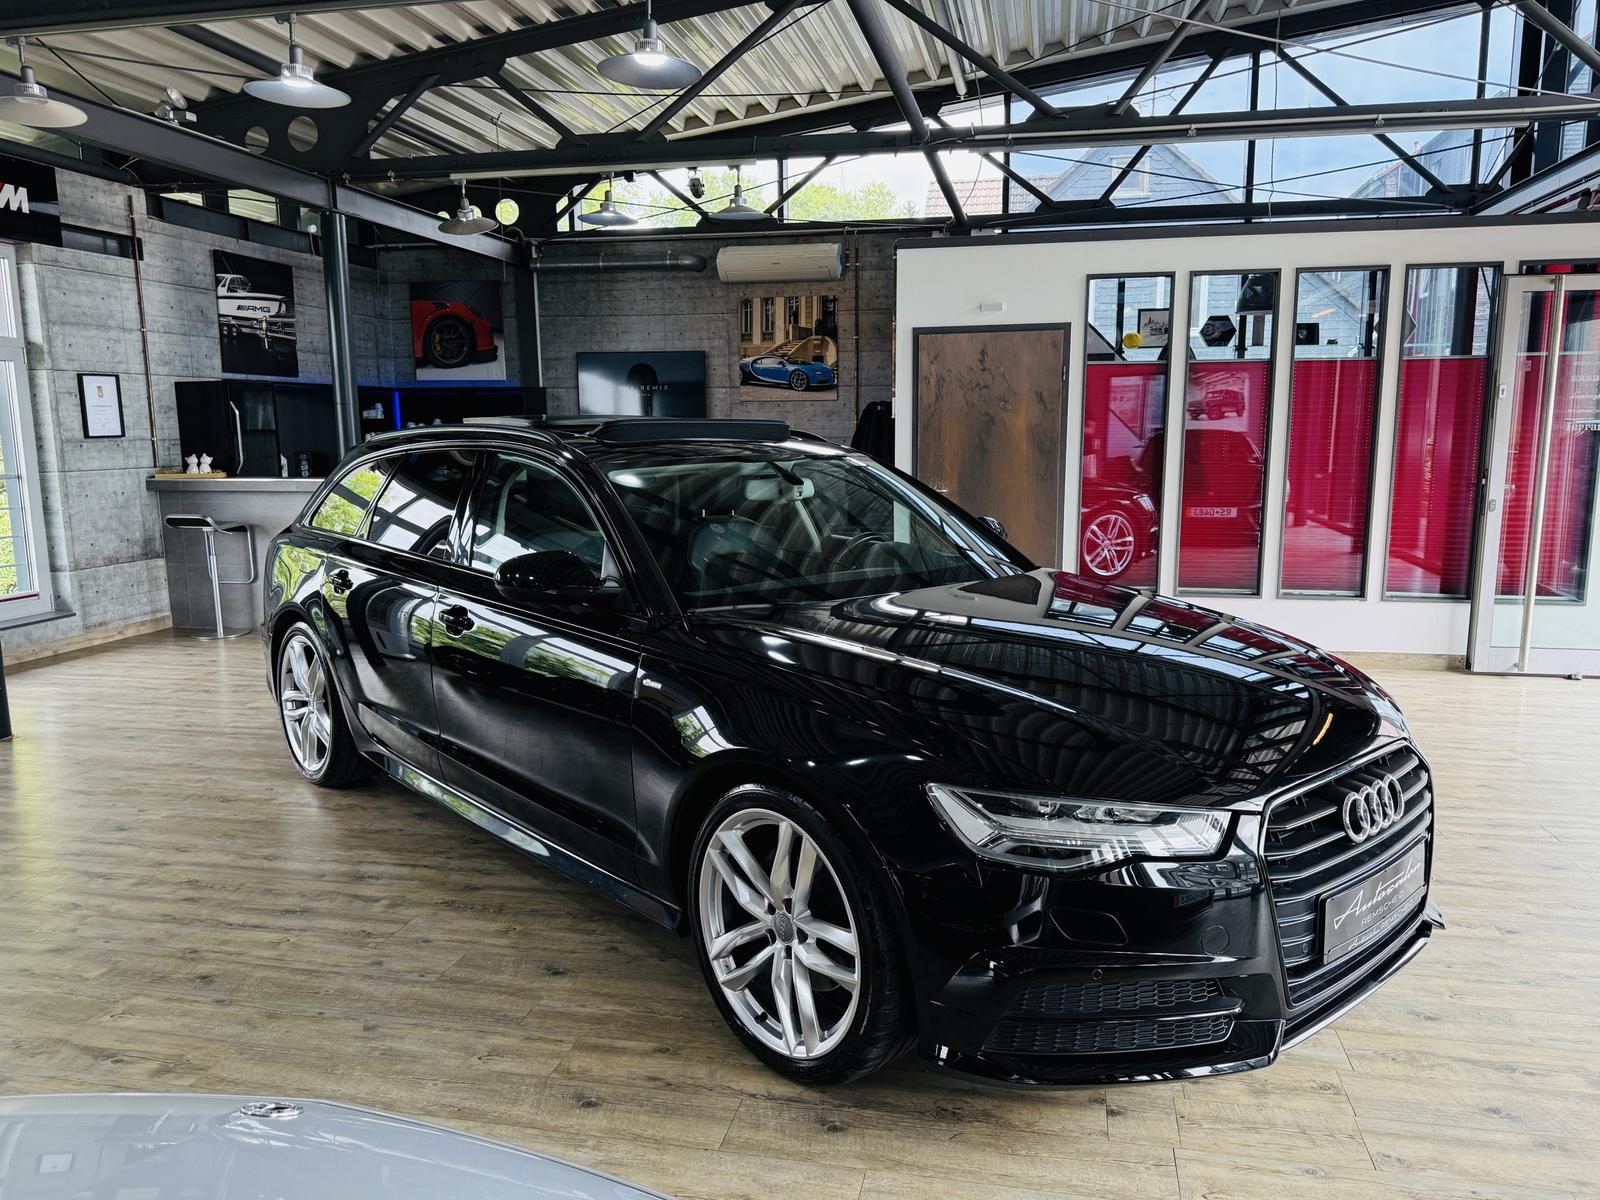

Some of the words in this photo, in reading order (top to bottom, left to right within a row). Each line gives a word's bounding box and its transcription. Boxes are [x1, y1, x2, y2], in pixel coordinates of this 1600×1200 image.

[0, 183, 30, 214] M
[246, 305, 271, 313] AMG
[1334, 857, 1421, 930] Autosalon
[1361, 890, 1405, 926] REMSCHEID
